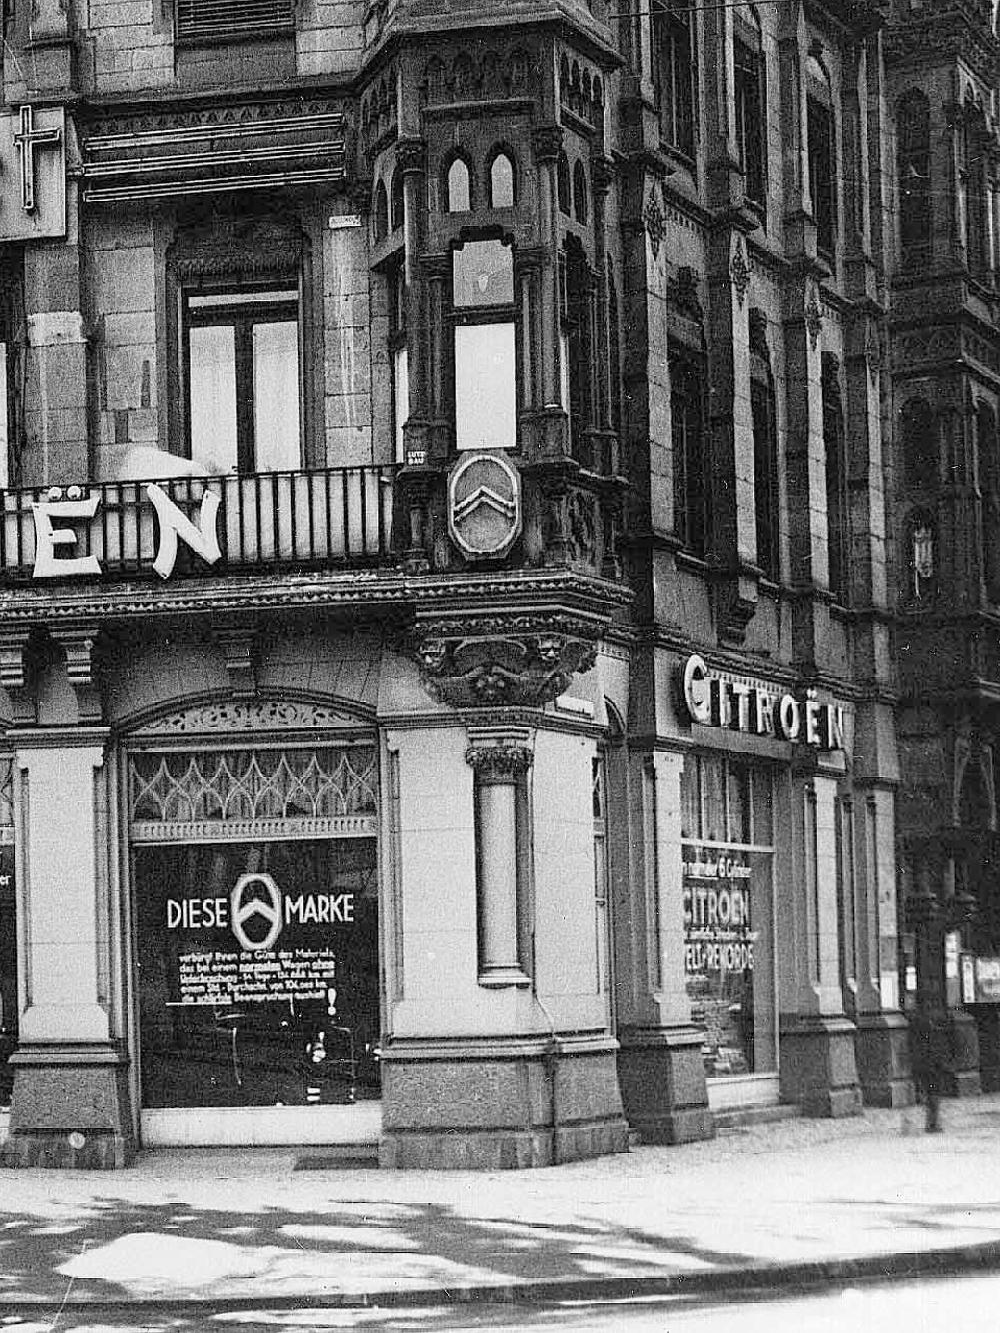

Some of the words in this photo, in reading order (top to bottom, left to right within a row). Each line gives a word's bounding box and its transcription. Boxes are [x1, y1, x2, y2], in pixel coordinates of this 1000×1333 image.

[684, 653, 845, 749] CITROËN
[167, 897, 228, 929] DIESE
[285, 893, 355, 925] MARKE
